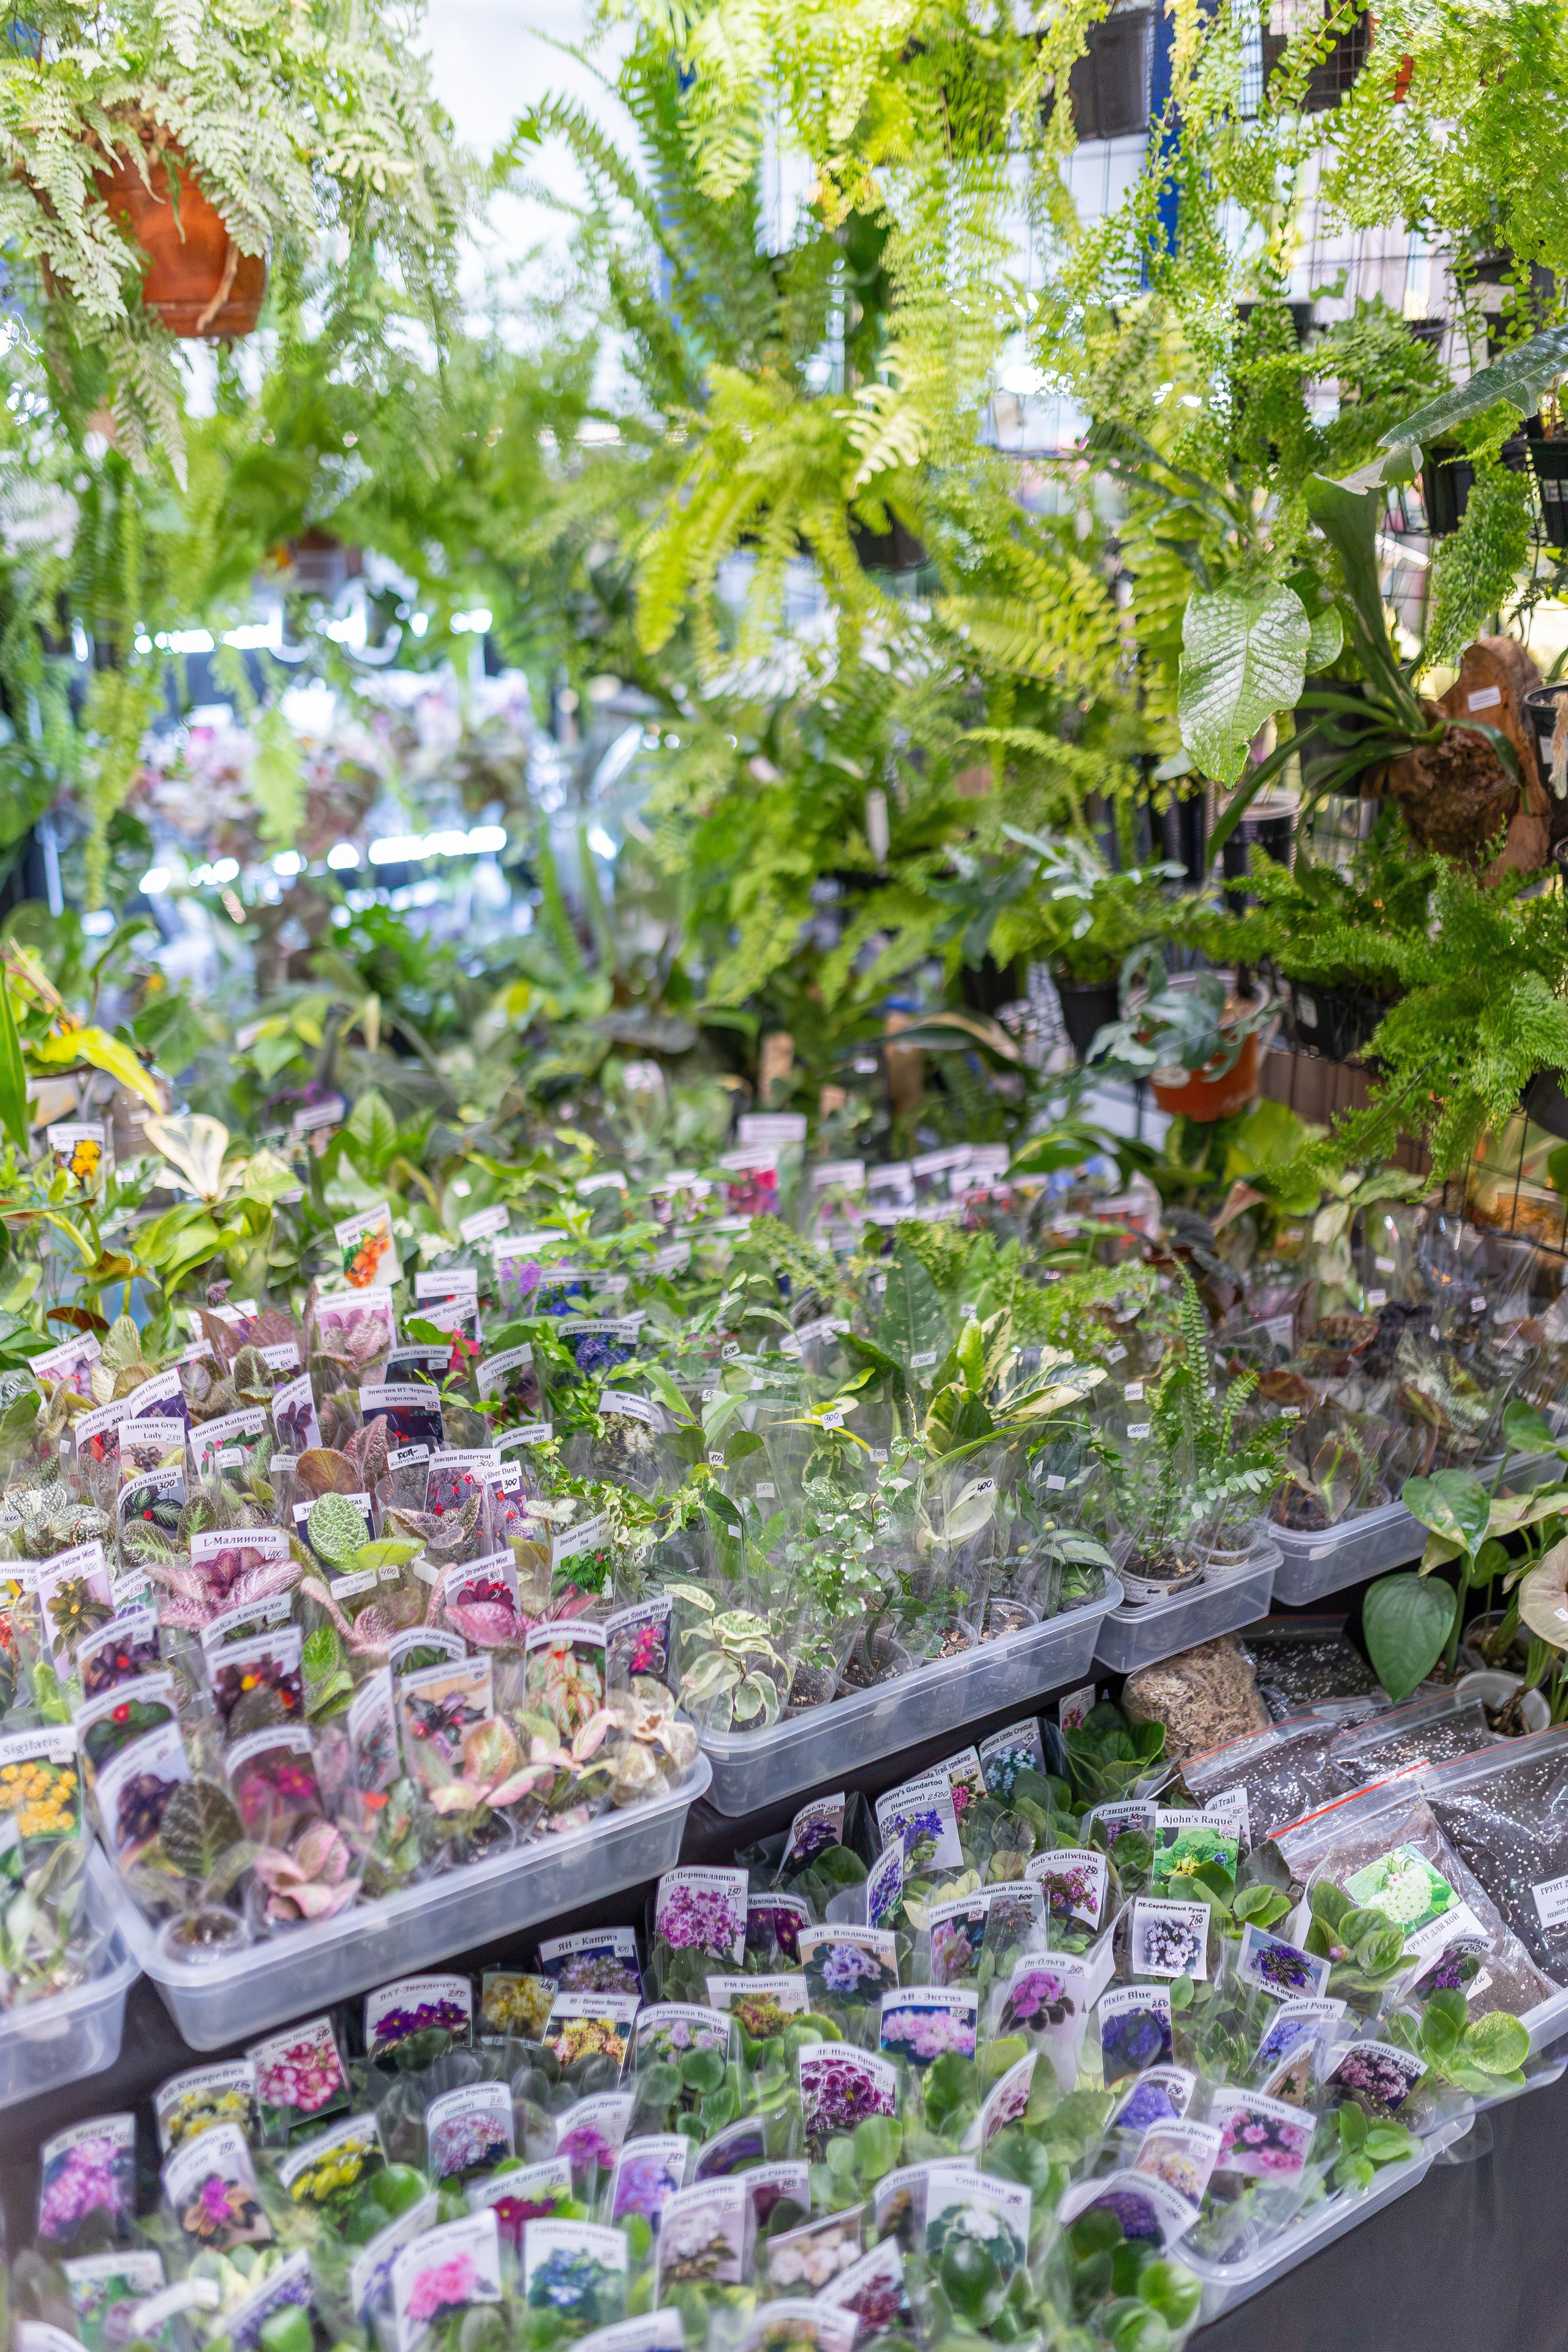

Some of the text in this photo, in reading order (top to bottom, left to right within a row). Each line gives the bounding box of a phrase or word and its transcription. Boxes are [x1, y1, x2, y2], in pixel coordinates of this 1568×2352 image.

[598, 1322, 634, 1333] Голубая
[263, 1348, 294, 1359] Emerald
[145, 1374, 175, 1393] Chocolate
[366, 1388, 396, 1396] Эписция
[140, 1392, 159, 1407] Velour
[91, 1403, 124, 1420] Raspberry
[823, 1412, 840, 1423] 900
[124, 1421, 178, 1432] Эписция Grey
[193, 1412, 262, 1439] Эписция Katherine
[1128, 1425, 1150, 1434] 1000
[143, 1431, 163, 1440] Lady
[511, 1428, 545, 1439] Sensitivum
[432, 1452, 491, 1464] Эписция Butternut
[476, 1459, 494, 1468] 300
[501, 1466, 518, 1475] Dust
[133, 1471, 177, 1488] Голландка
[158, 1479, 176, 1491] 300
[503, 1477, 518, 1489] 300
[978, 1479, 993, 1491] 400
[3, 1514, 19, 1523] 1000
[576, 1521, 598, 1539] Harmony's
[203, 1534, 277, 1548] L-Малиновка
[579, 1538, 590, 1547] Pink
[60, 1555, 81, 1568] Yellow
[81, 1548, 97, 1561] Mist
[266, 1550, 284, 1560] 400
[464, 1561, 496, 1578] Strawberry
[496, 1556, 508, 1567] Mist
[630, 1608, 649, 1619] Snow
[649, 1602, 669, 1613] White
[1000, 1721, 1034, 1742] Little Crystal
[933, 1763, 949, 1777] Trail
[963, 1767, 976, 1776] 300
[876, 1778, 943, 1811] Harmony's Gundartoo
[927, 1790, 950, 1802] 2500
[890, 1792, 926, 1812] (Harmony)
[1218, 1795, 1237, 1807] Trail
[1128, 1813, 1143, 1822] 300
[1163, 1814, 1234, 1827] Ajohn's Raque
[1030, 1852, 1099, 1870] Rob's Galiwinku
[1085, 1865, 1099, 1875] 250
[726, 1888, 742, 1898] 250
[1540, 1880, 1563, 1896] ГРУНТ
[969, 1909, 984, 1920] 250
[1406, 1934, 1432, 1953] ГРУНТ
[1431, 1923, 1446, 1939] ДЛЯ
[1443, 1911, 1460, 1927] ХОЙ
[558, 1935, 618, 1952] ЯН Каприз
[900, 1992, 962, 2003] АВ Экстаз
[1103, 1990, 1152, 2008] Pixie Blue
[1151, 1999, 1169, 2009] 250
[1310, 2001, 1336, 2013] Pony
[1363, 2042, 1396, 2058] Vanilla
